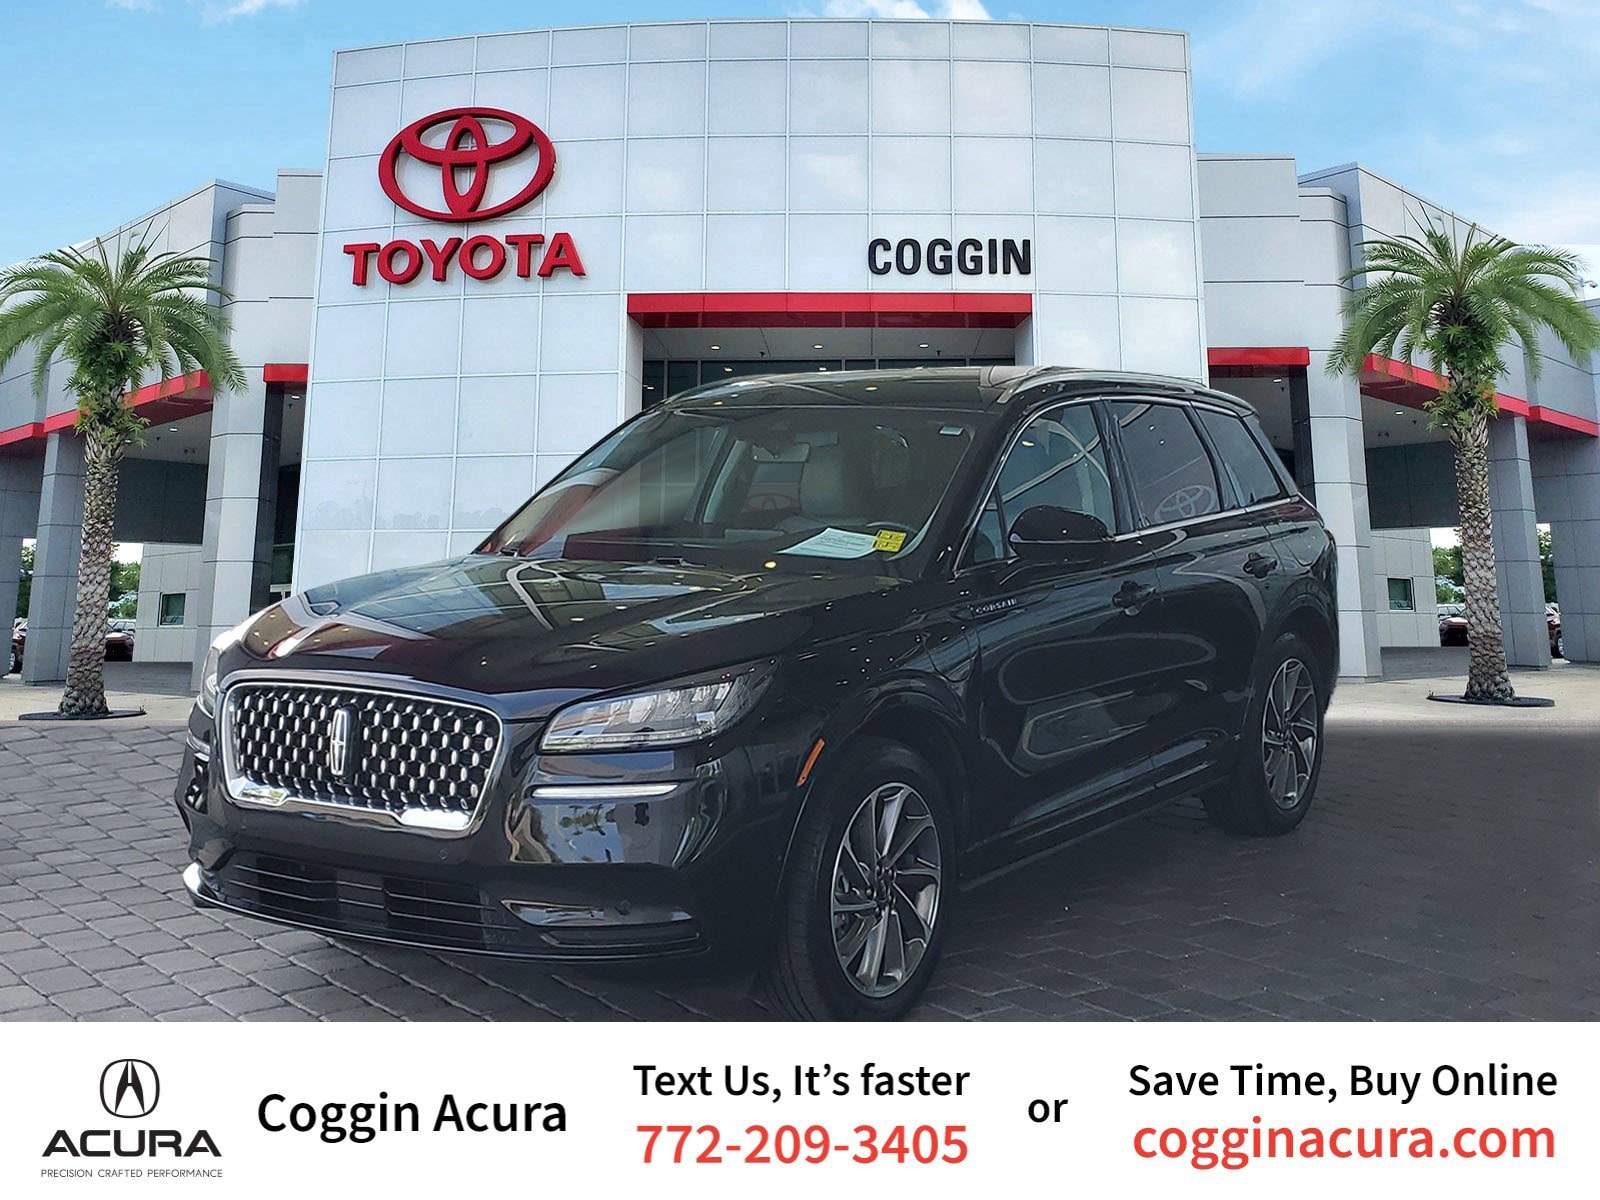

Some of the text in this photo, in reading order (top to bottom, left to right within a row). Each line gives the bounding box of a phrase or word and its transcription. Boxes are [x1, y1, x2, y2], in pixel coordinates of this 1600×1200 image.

[344, 232, 585, 286] TOYOTA
[867, 238, 1033, 276] COGGIN
[974, 597, 1018, 615] CORSAIR
